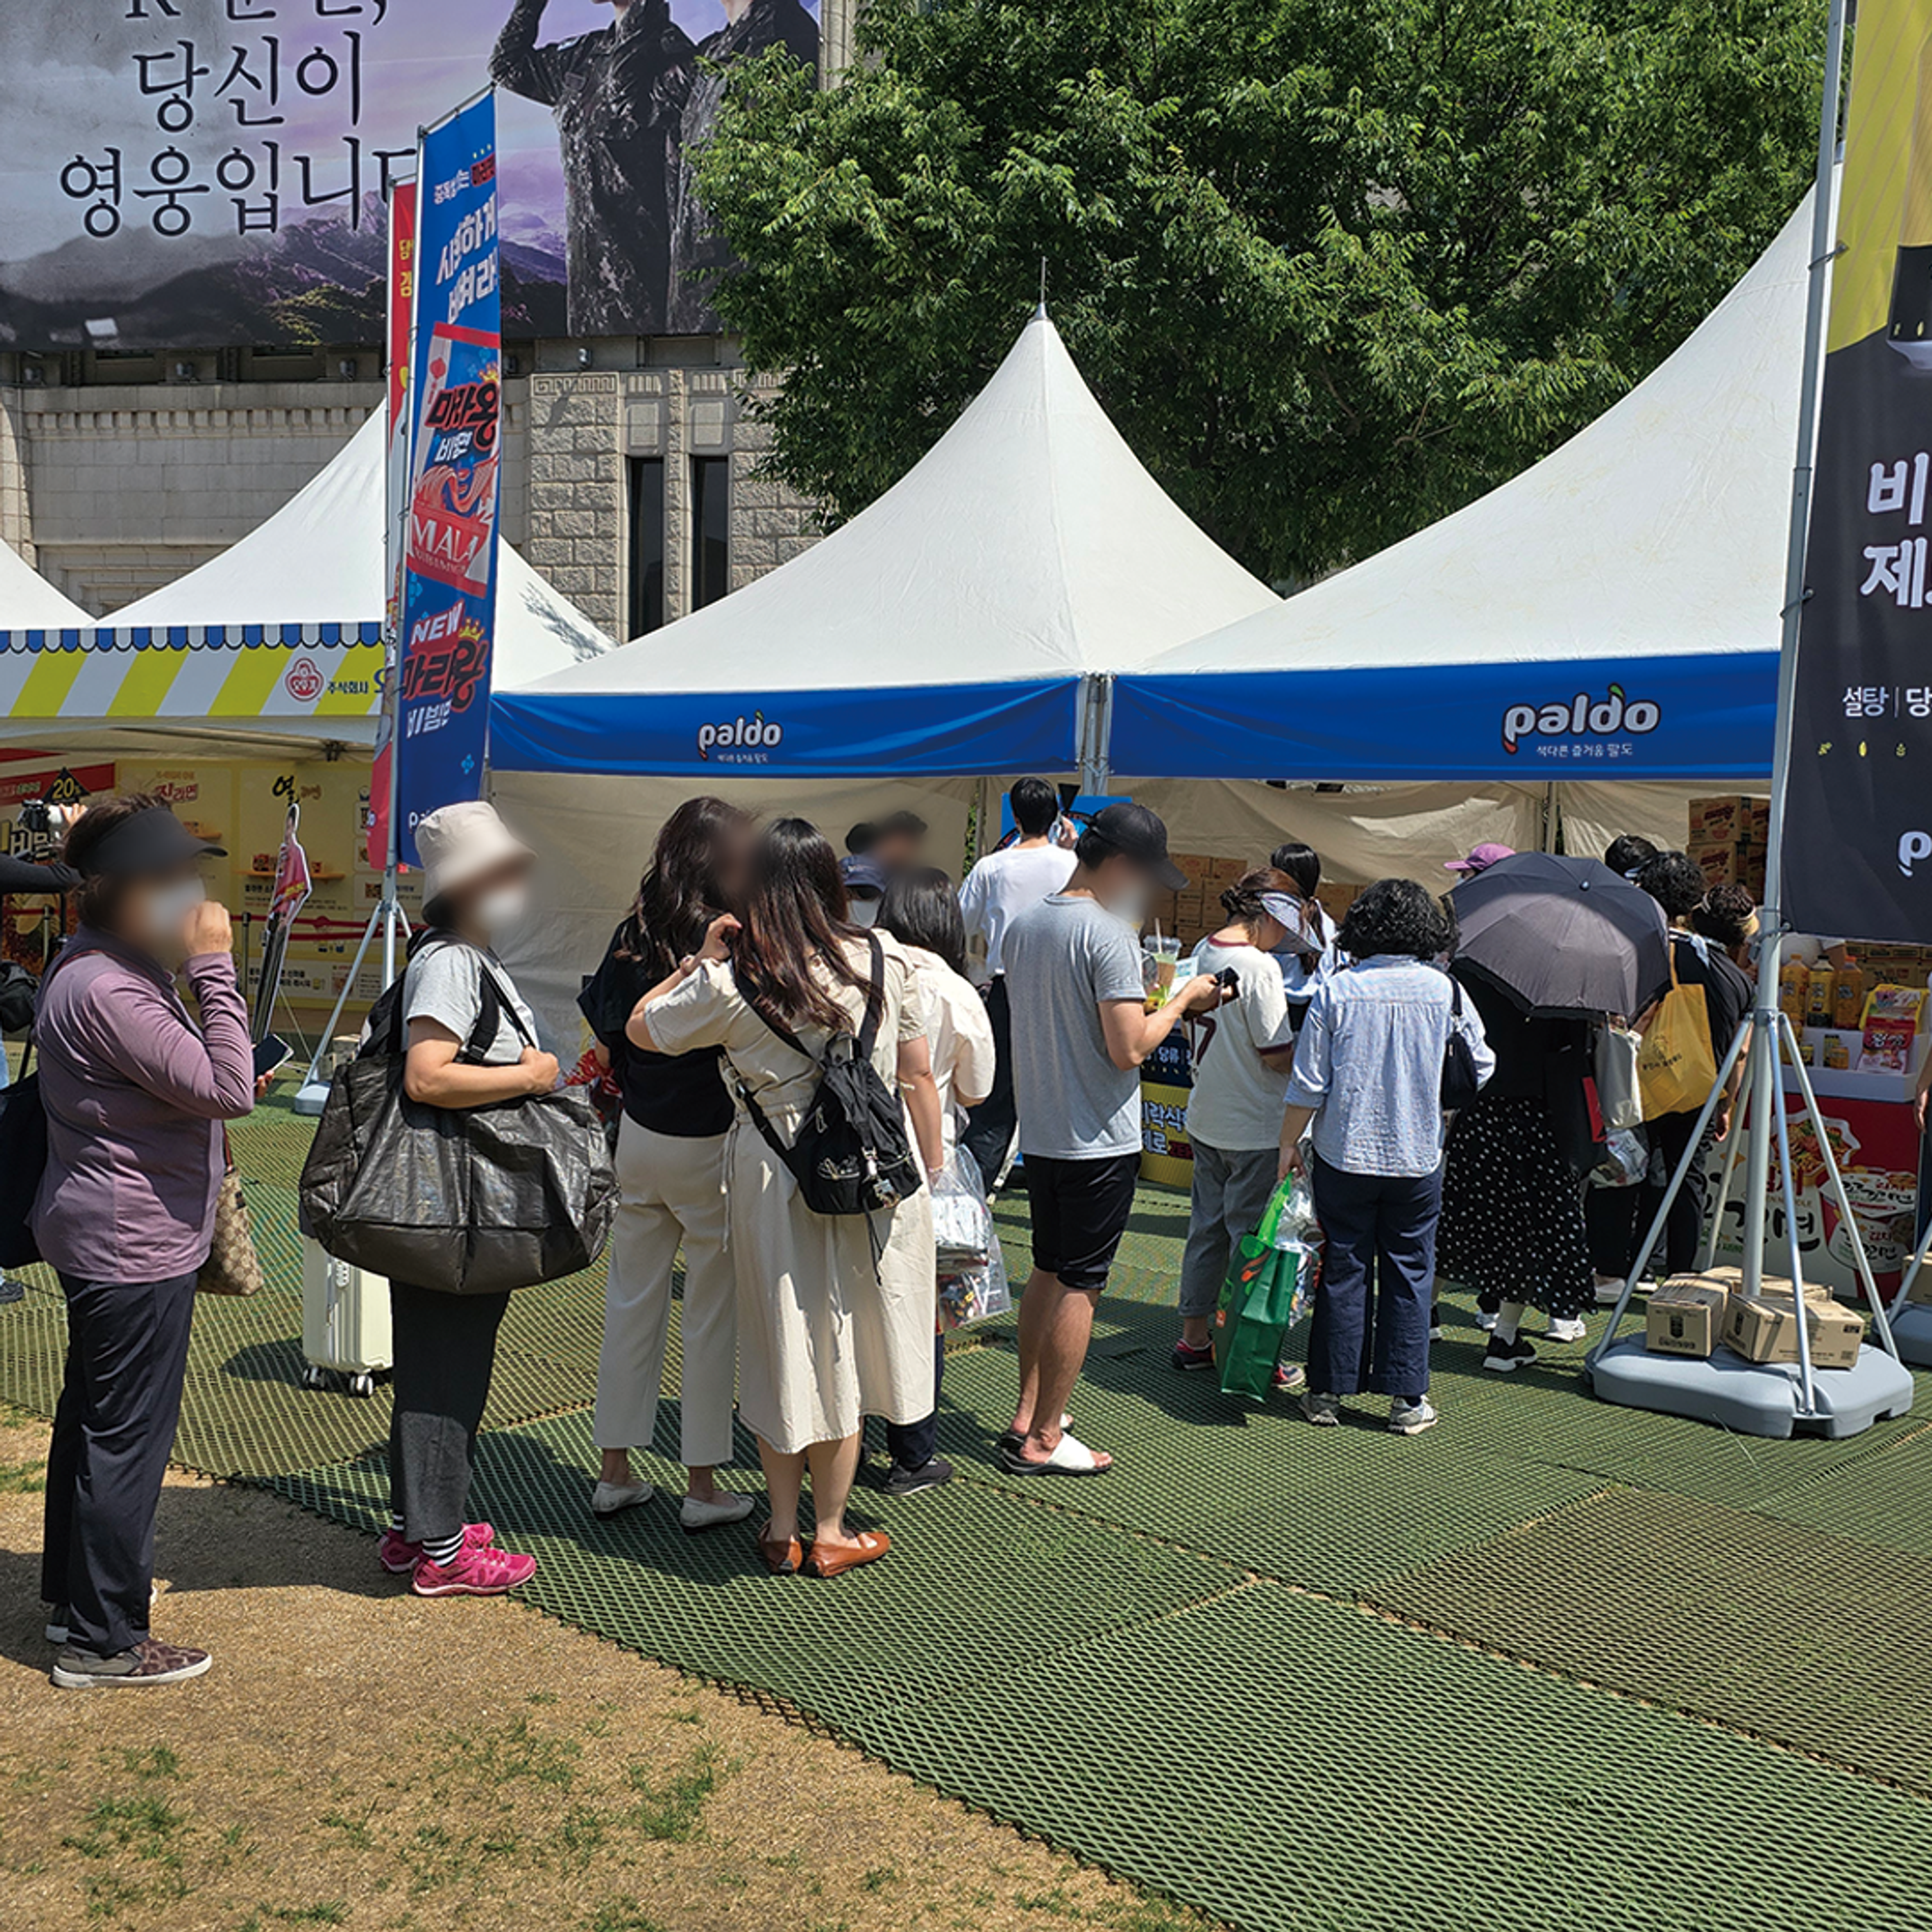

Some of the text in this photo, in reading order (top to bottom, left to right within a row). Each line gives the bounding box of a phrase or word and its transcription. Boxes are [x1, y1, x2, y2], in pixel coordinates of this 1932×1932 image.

[132, 30, 361, 133] 당신이
[1867, 452, 1929, 525] 비
[1860, 536, 1932, 607] 제
[411, 602, 462, 645] NEW
[697, 709, 783, 760] paldo
[1501, 682, 1661, 754] paldo
[1842, 686, 1890, 717] 설탕
